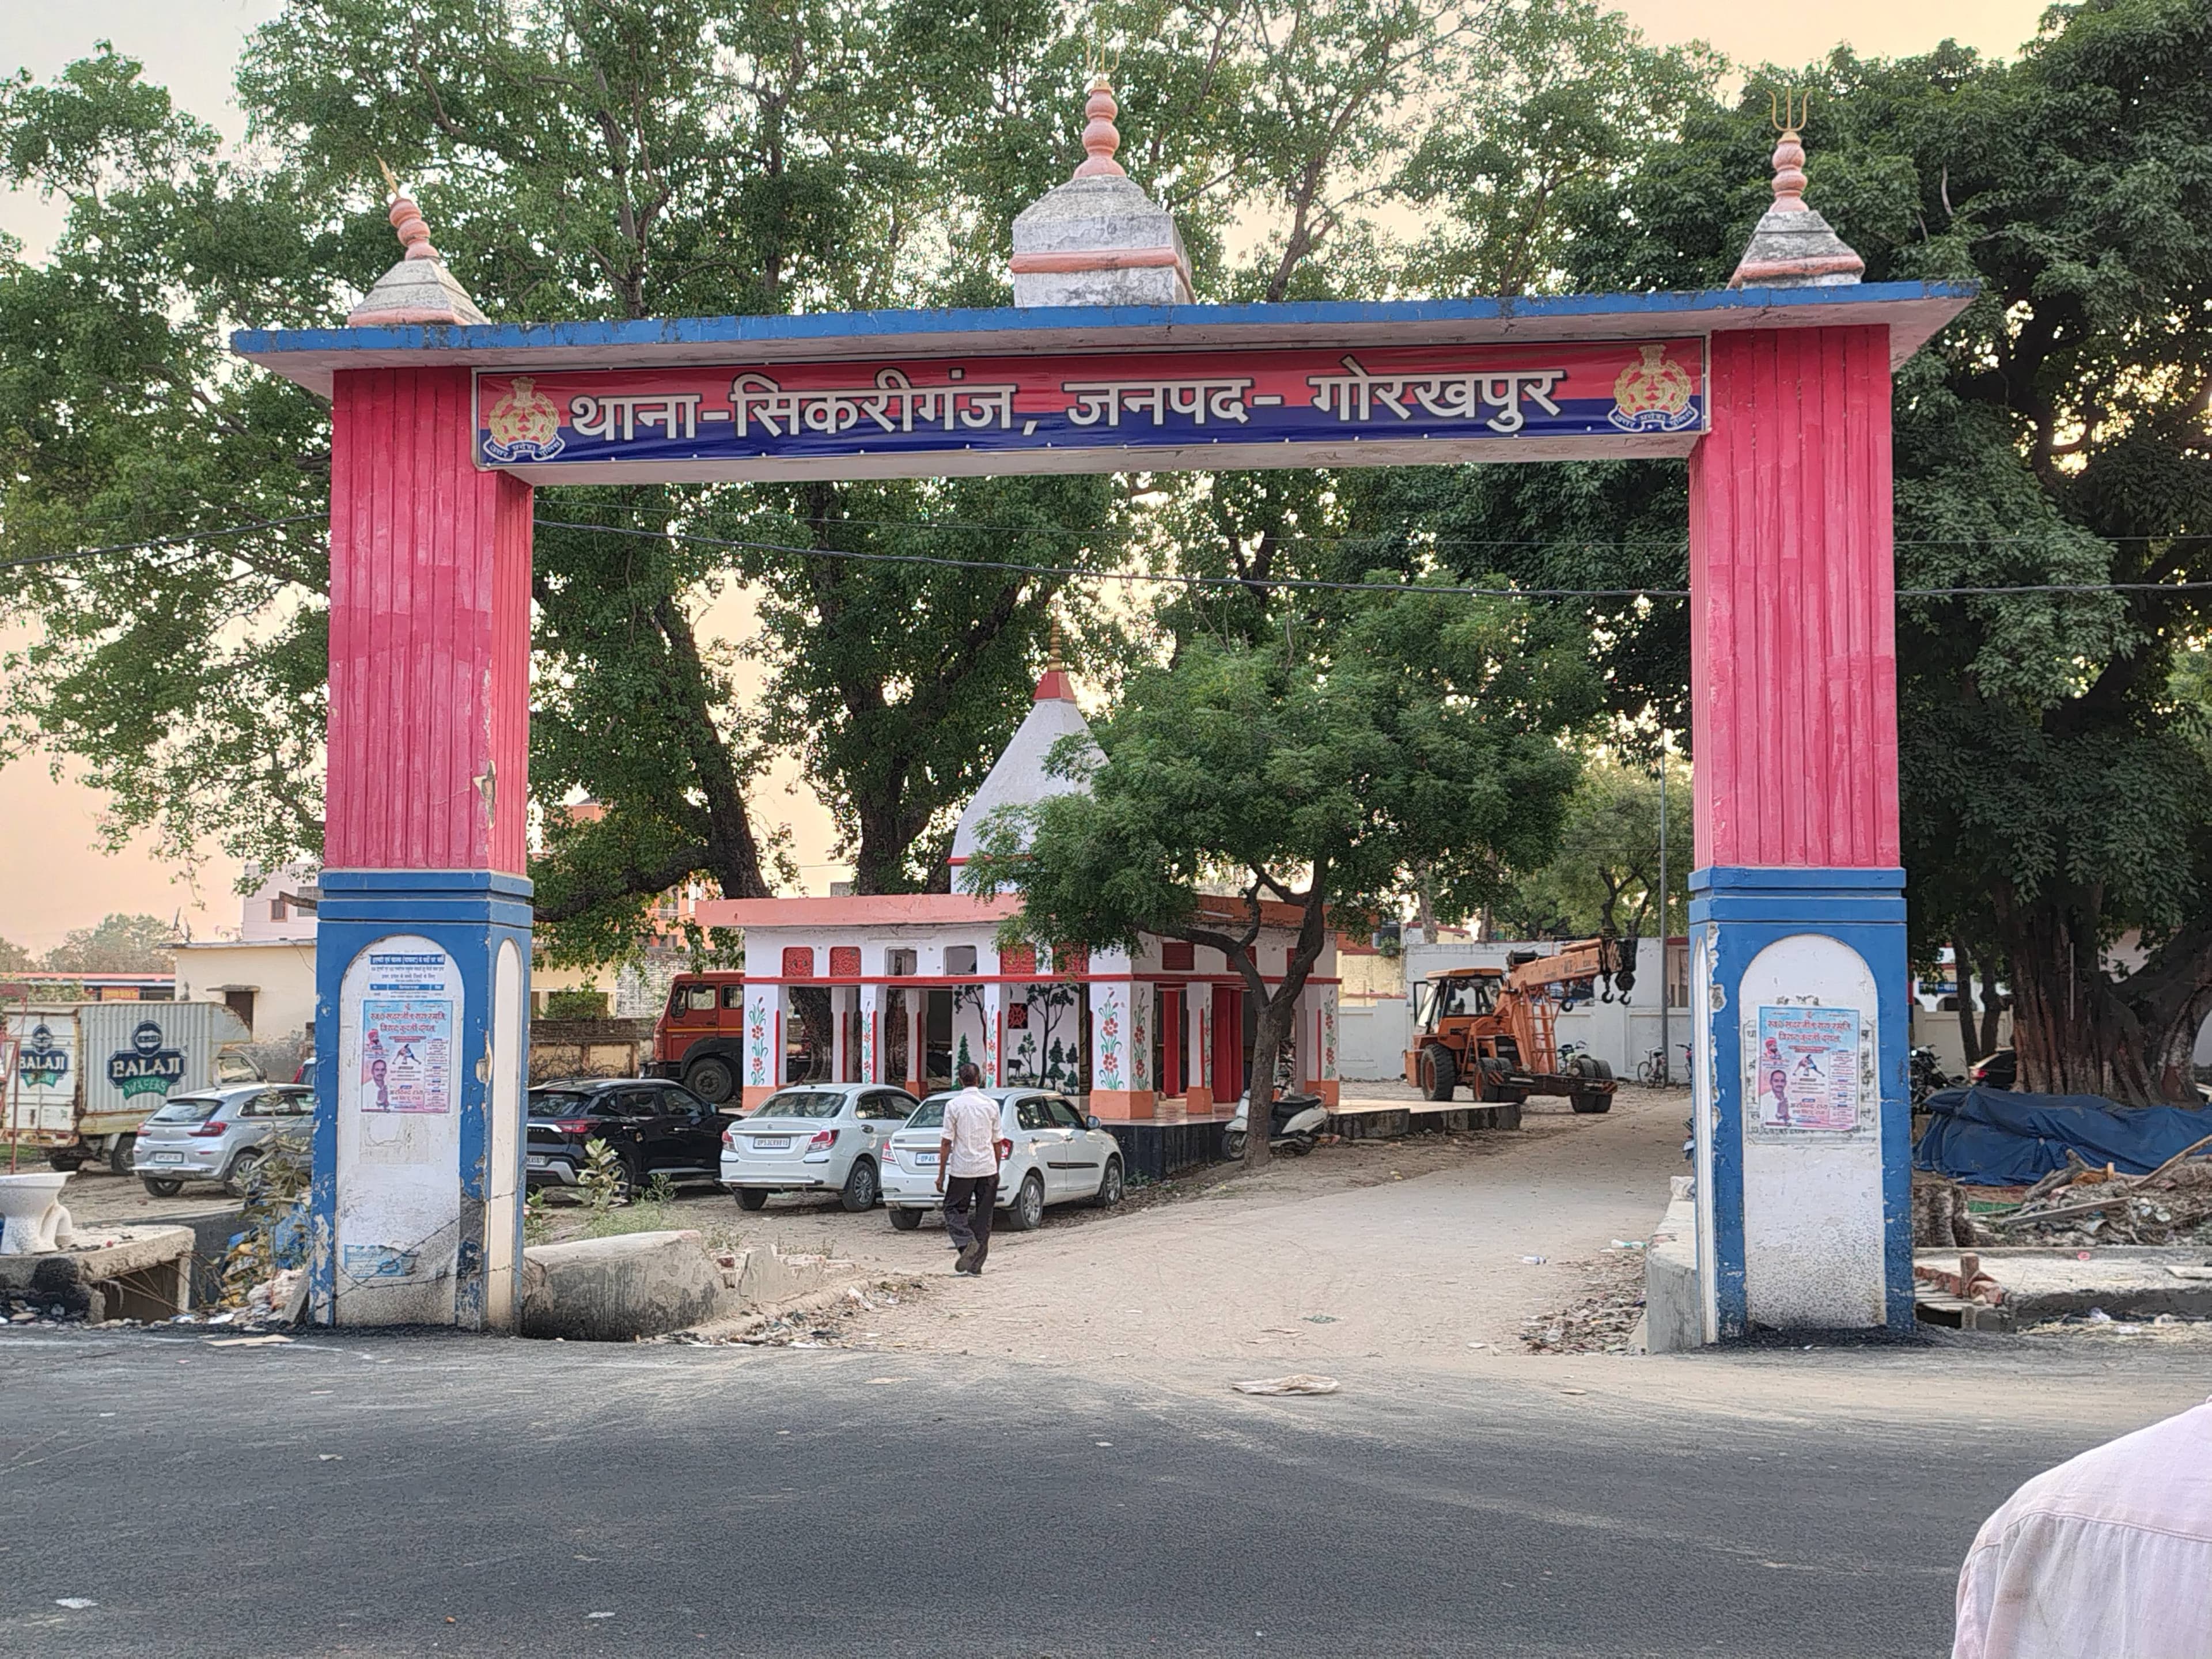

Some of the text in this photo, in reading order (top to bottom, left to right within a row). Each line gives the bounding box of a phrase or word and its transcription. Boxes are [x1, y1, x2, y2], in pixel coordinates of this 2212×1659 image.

[1062, 377, 1282, 427] जनपद-
[1305, 353, 1566, 434] गोरखपुर
[20, 1056, 65, 1070] BALAJI
[112, 1057, 181, 1077] BALAJI
